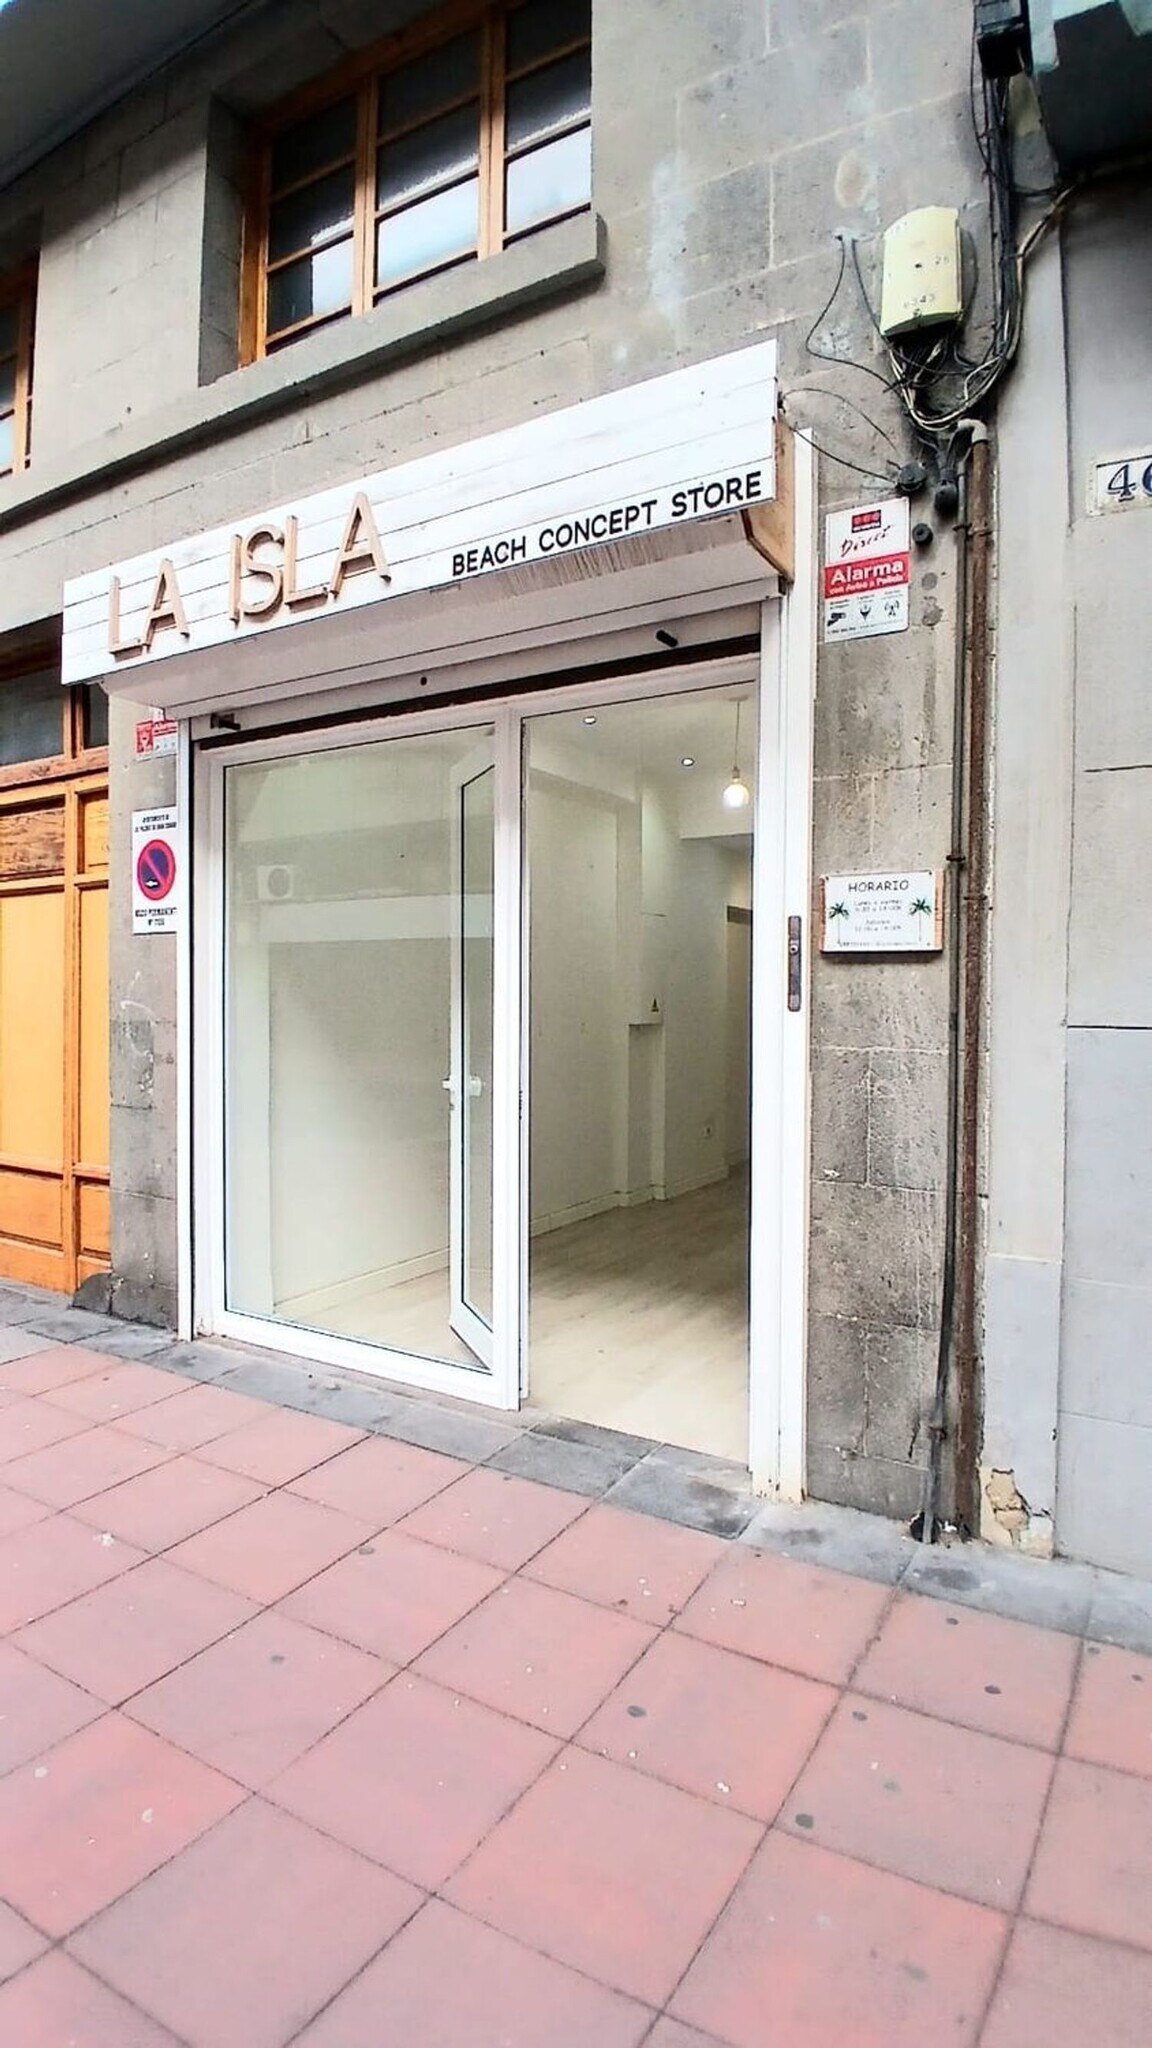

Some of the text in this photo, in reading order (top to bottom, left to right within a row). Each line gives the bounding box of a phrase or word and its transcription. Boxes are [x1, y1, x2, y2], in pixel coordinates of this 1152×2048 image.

[452, 471, 762, 576] BEACH CONCEPT STORE
[109, 491, 392, 661] LA ISLA
[830, 560, 904, 586] Alarma
[848, 879, 909, 893] HORARIO
